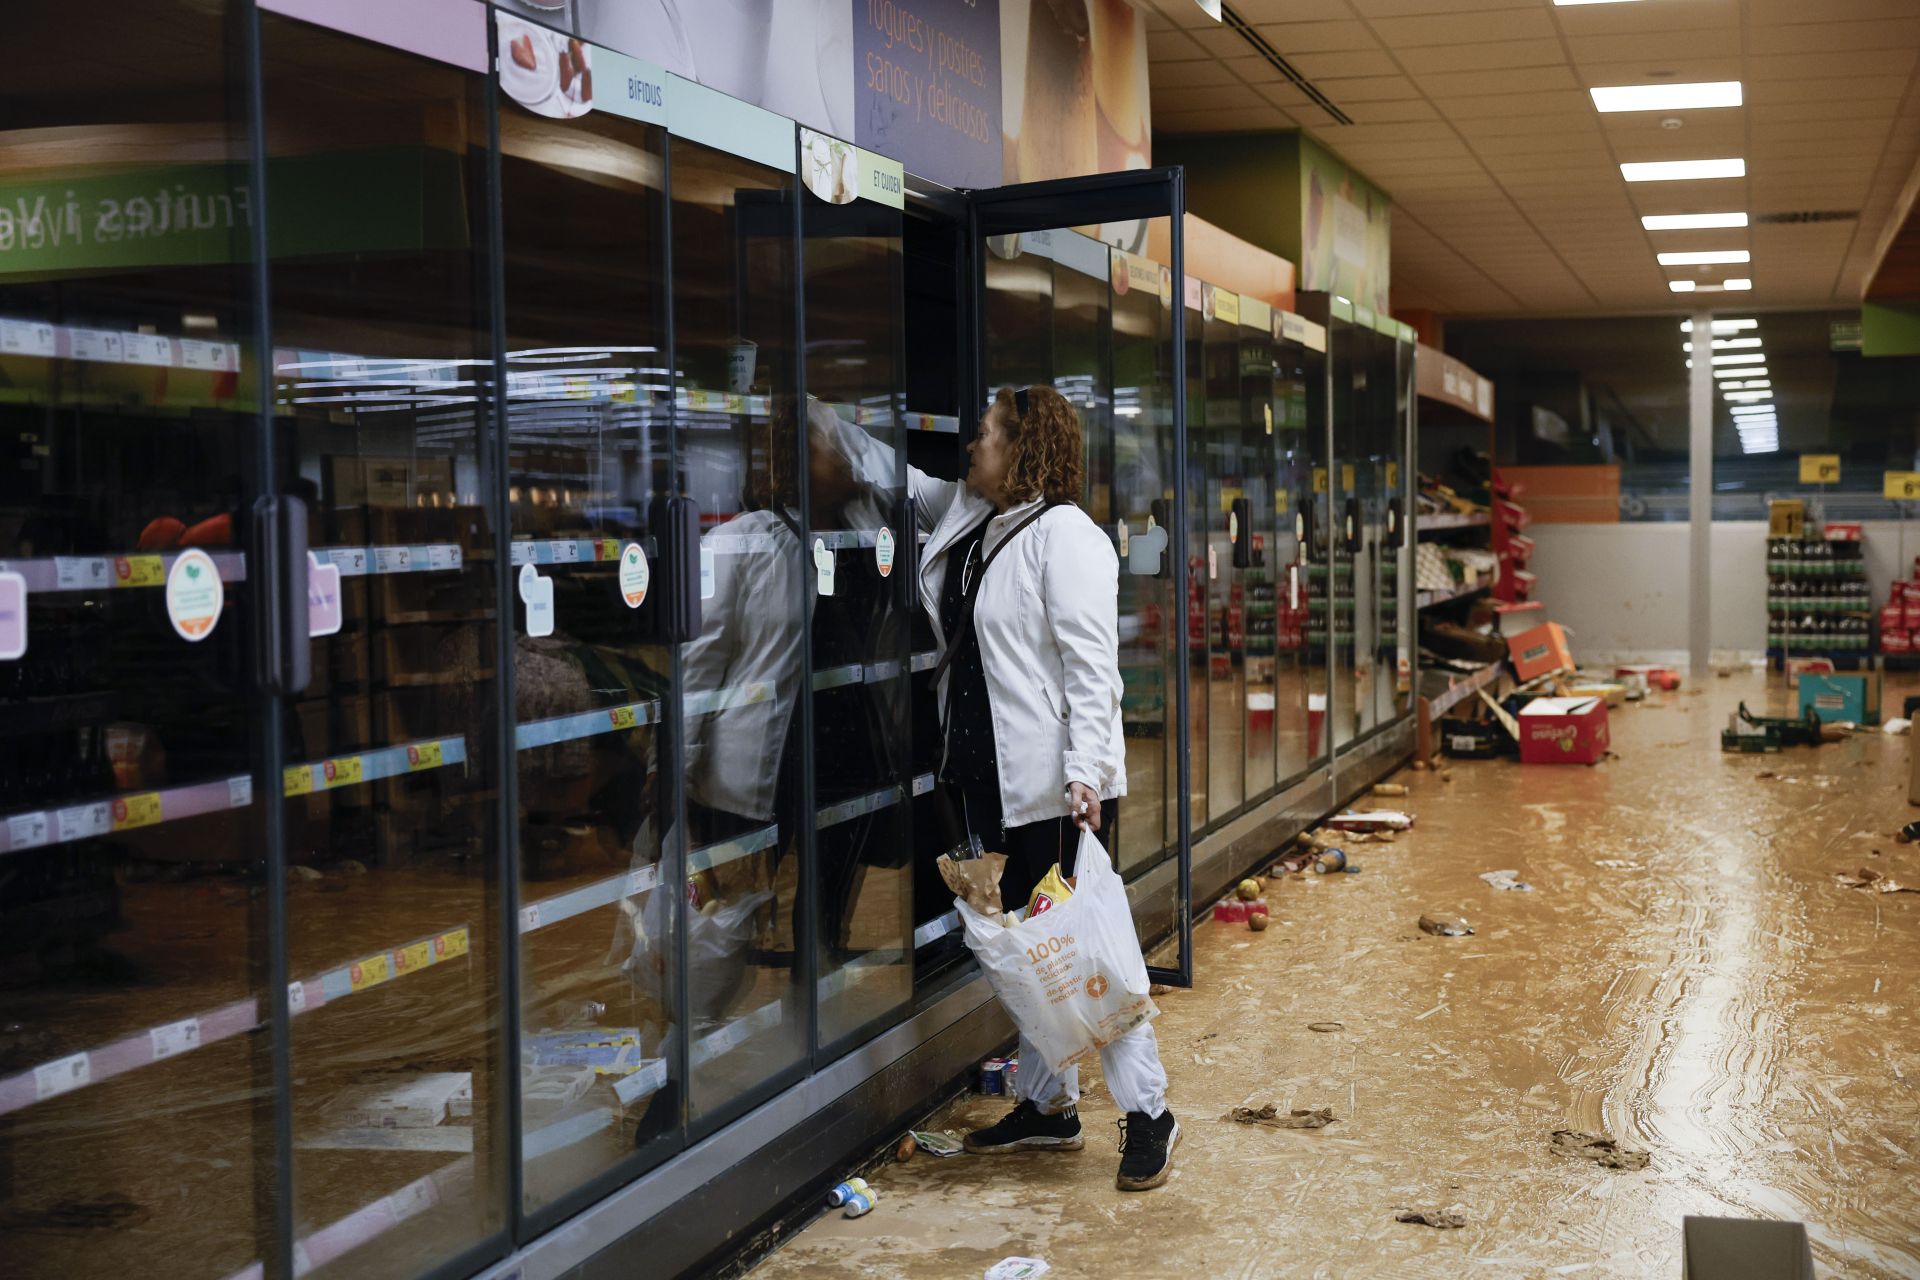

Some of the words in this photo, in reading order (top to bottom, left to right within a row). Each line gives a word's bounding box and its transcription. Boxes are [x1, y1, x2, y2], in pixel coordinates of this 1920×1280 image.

[926, 24, 934, 71] y
[867, 51, 911, 105] sanos
[915, 76, 923, 123] y
[928, 71, 989, 144] deliciosos
[874, 169, 880, 188] ET
[881, 172, 901, 195] CUIDEN
[1026, 934, 1075, 965] 100%
[1035, 965, 1046, 976] de
